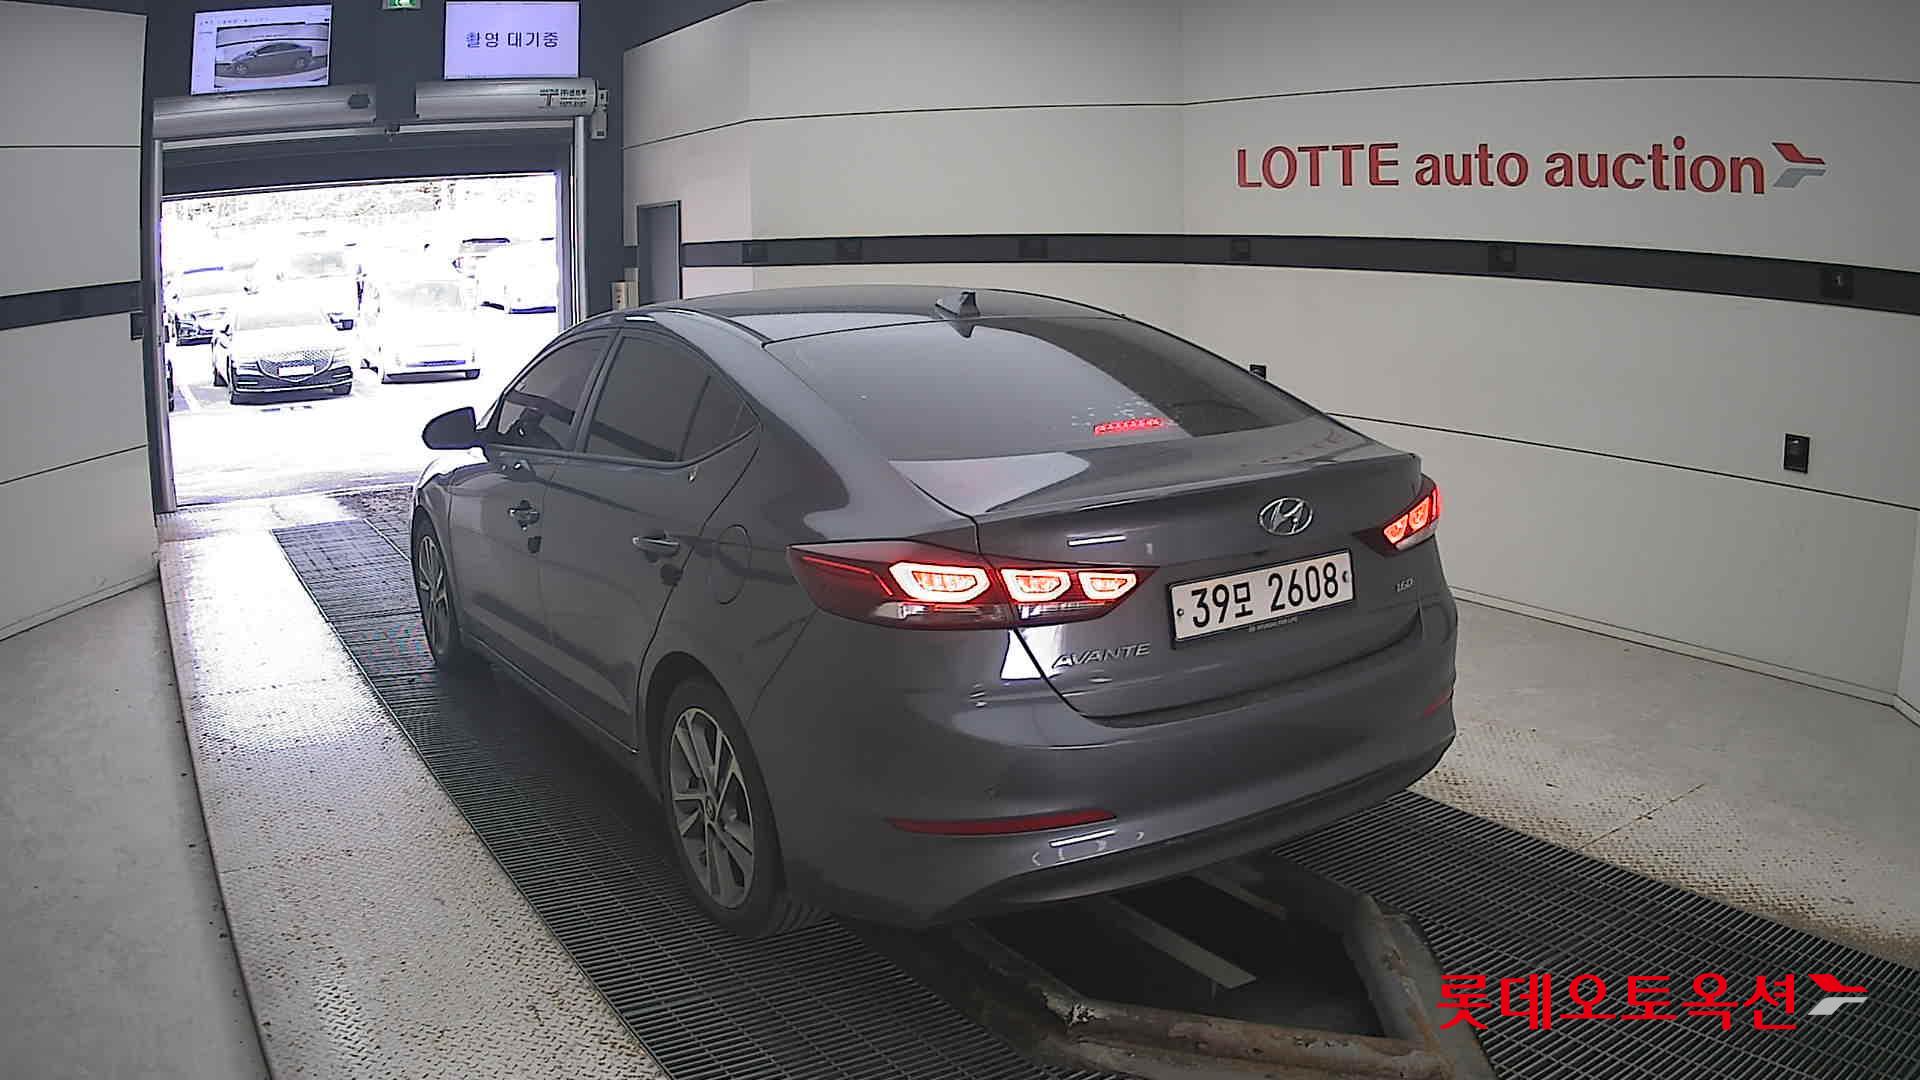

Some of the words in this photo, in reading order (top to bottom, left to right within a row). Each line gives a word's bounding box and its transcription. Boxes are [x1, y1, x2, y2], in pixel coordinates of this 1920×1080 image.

[507, 32, 559, 48] 대기중
[1237, 143, 1399, 188] LOTTE
[1415, 144, 1529, 187] auto
[1544, 136, 1766, 194] auction
[1191, 582, 1253, 628] 39모
[1268, 562, 1339, 612] 2608
[1052, 643, 1151, 668] AVANTE
